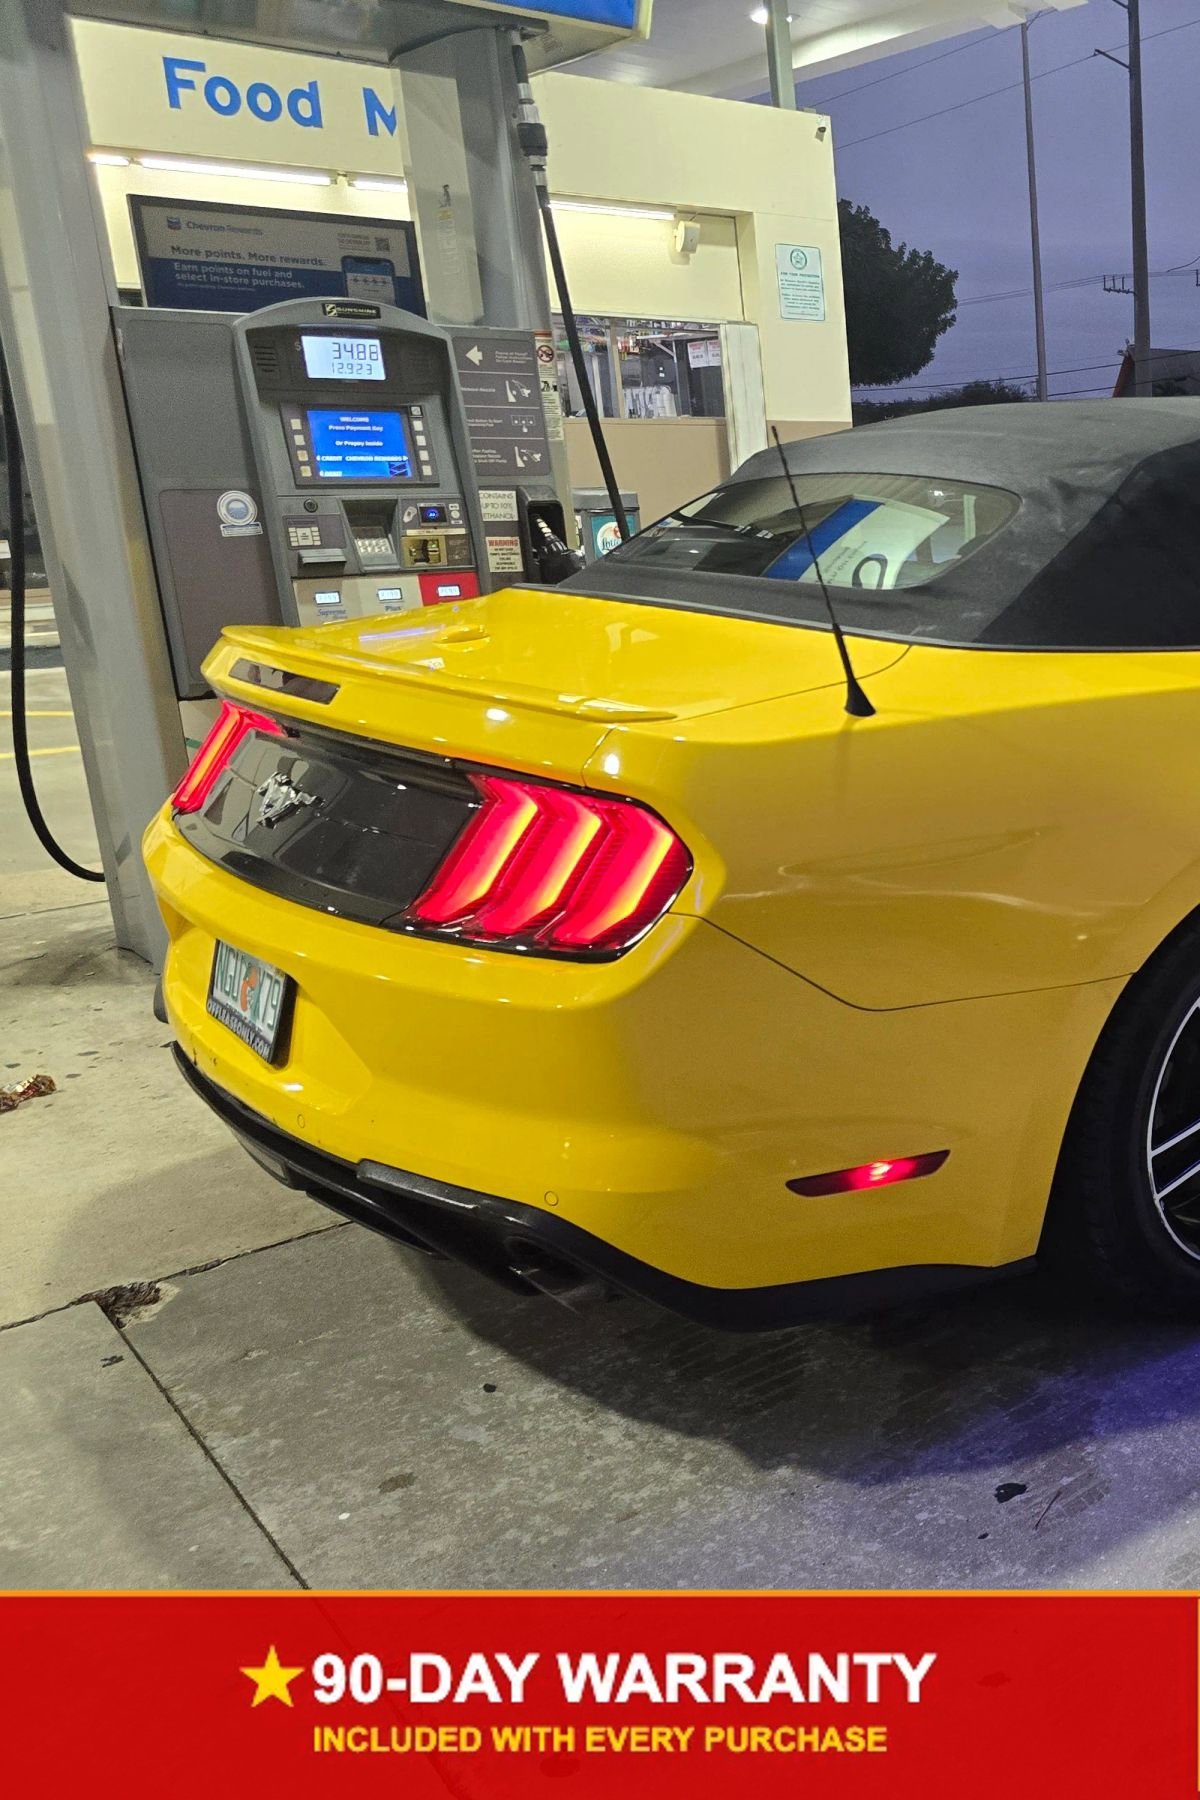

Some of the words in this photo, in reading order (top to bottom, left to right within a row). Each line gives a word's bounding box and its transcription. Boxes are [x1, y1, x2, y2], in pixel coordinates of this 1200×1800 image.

[162, 56, 324, 129] Food
[186, 220, 226, 232] Chevron
[170, 245, 202, 257] More
[205, 249, 246, 261] points.
[248, 251, 277, 263] More
[280, 255, 327, 267] rewards.
[174, 262, 199, 273] Earn
[202, 264, 234, 276] points
[236, 268, 250, 276] on
[252, 267, 272, 278] fuel
[274, 269, 293, 279] and
[175, 272, 207, 283] select
[210, 274, 250, 285] in-store
[253, 277, 305, 289] purchases.
